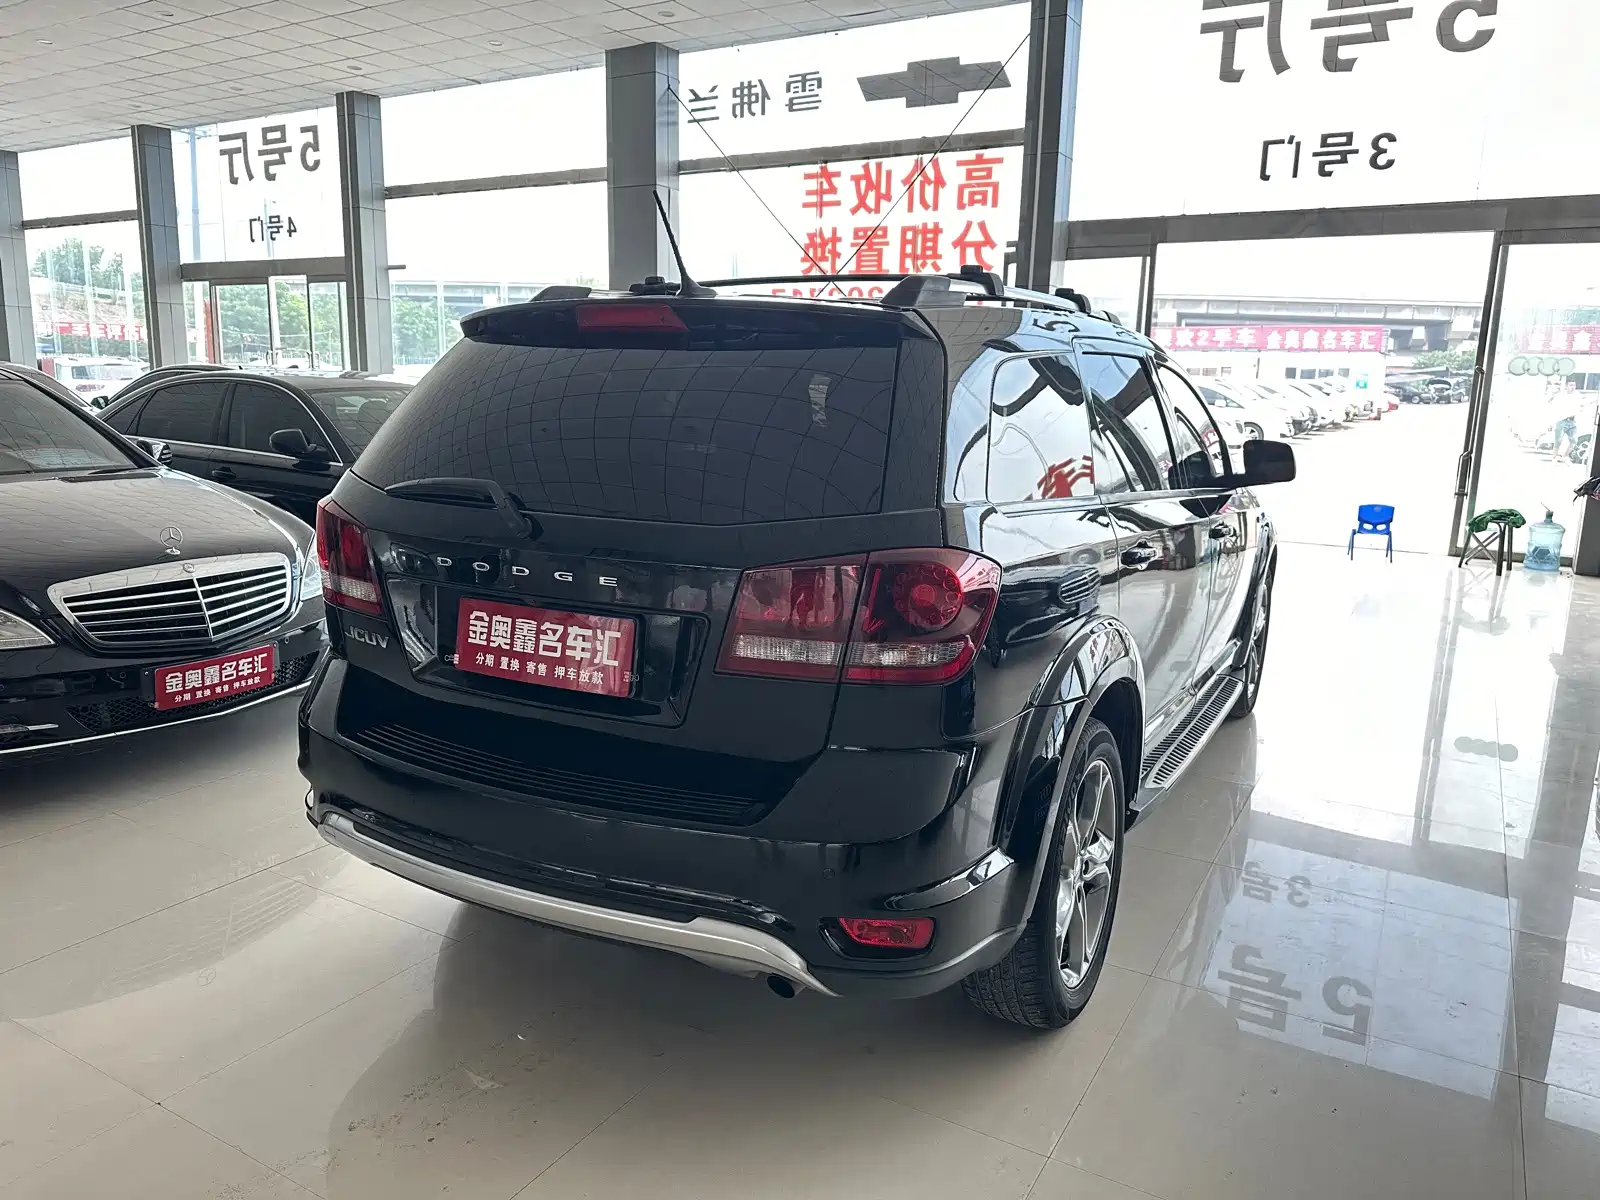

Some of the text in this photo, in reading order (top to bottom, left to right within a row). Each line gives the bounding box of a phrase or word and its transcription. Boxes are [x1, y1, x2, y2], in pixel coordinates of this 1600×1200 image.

[436, 557, 618, 587] DODGE
[345, 626, 389, 648] JCUV
[467, 610, 621, 667] 金奥鑫名车汇
[165, 653, 268, 693] 金奥鑫名车汇
[475, 652, 603, 685] 分期 置换 寄售 押车放款
